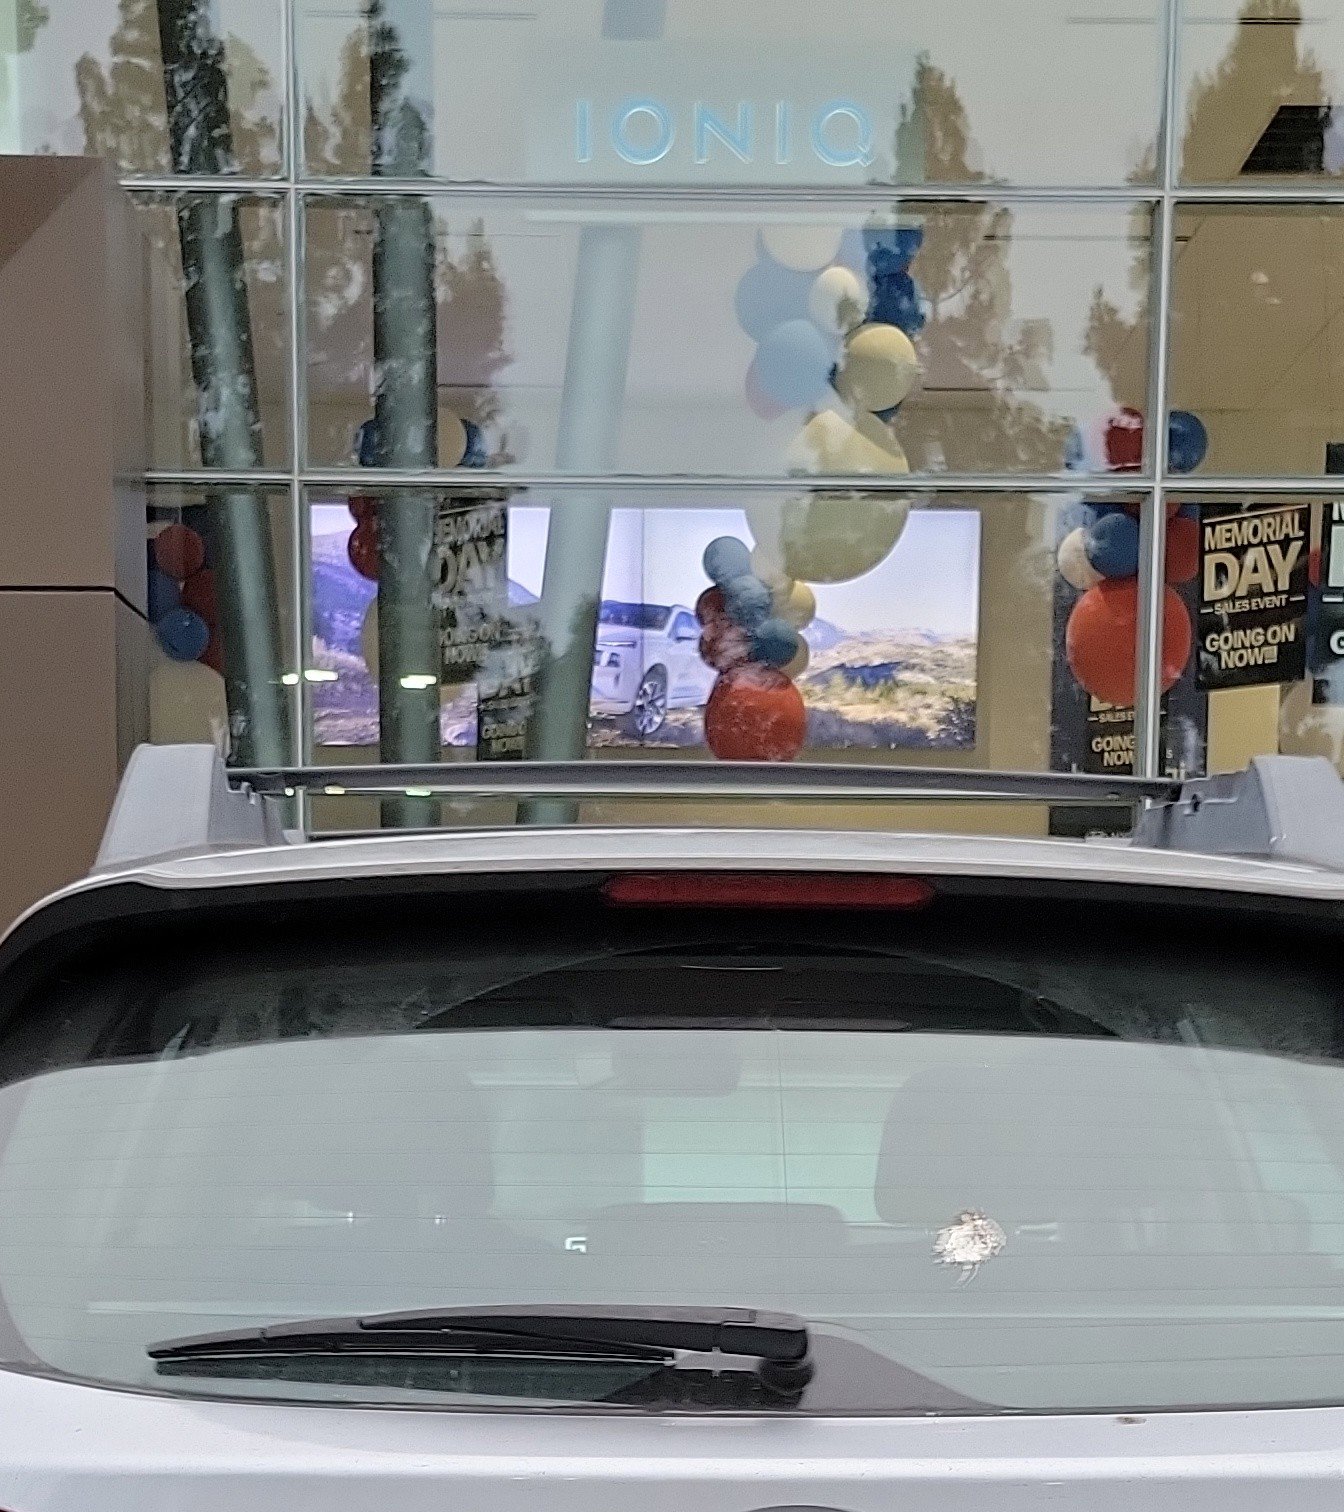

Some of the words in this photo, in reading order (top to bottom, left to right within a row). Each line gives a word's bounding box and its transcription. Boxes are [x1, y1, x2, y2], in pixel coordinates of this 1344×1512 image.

[575, 98, 875, 167] IONIQ
[1205, 514, 1305, 551] MEMORIAL
[1203, 540, 1304, 602] DAY
[1214, 600, 1250, 615] SALES
[1251, 595, 1289, 611] EVENT
[1206, 628, 1265, 653] GOING
[1266, 623, 1296, 644] ON
